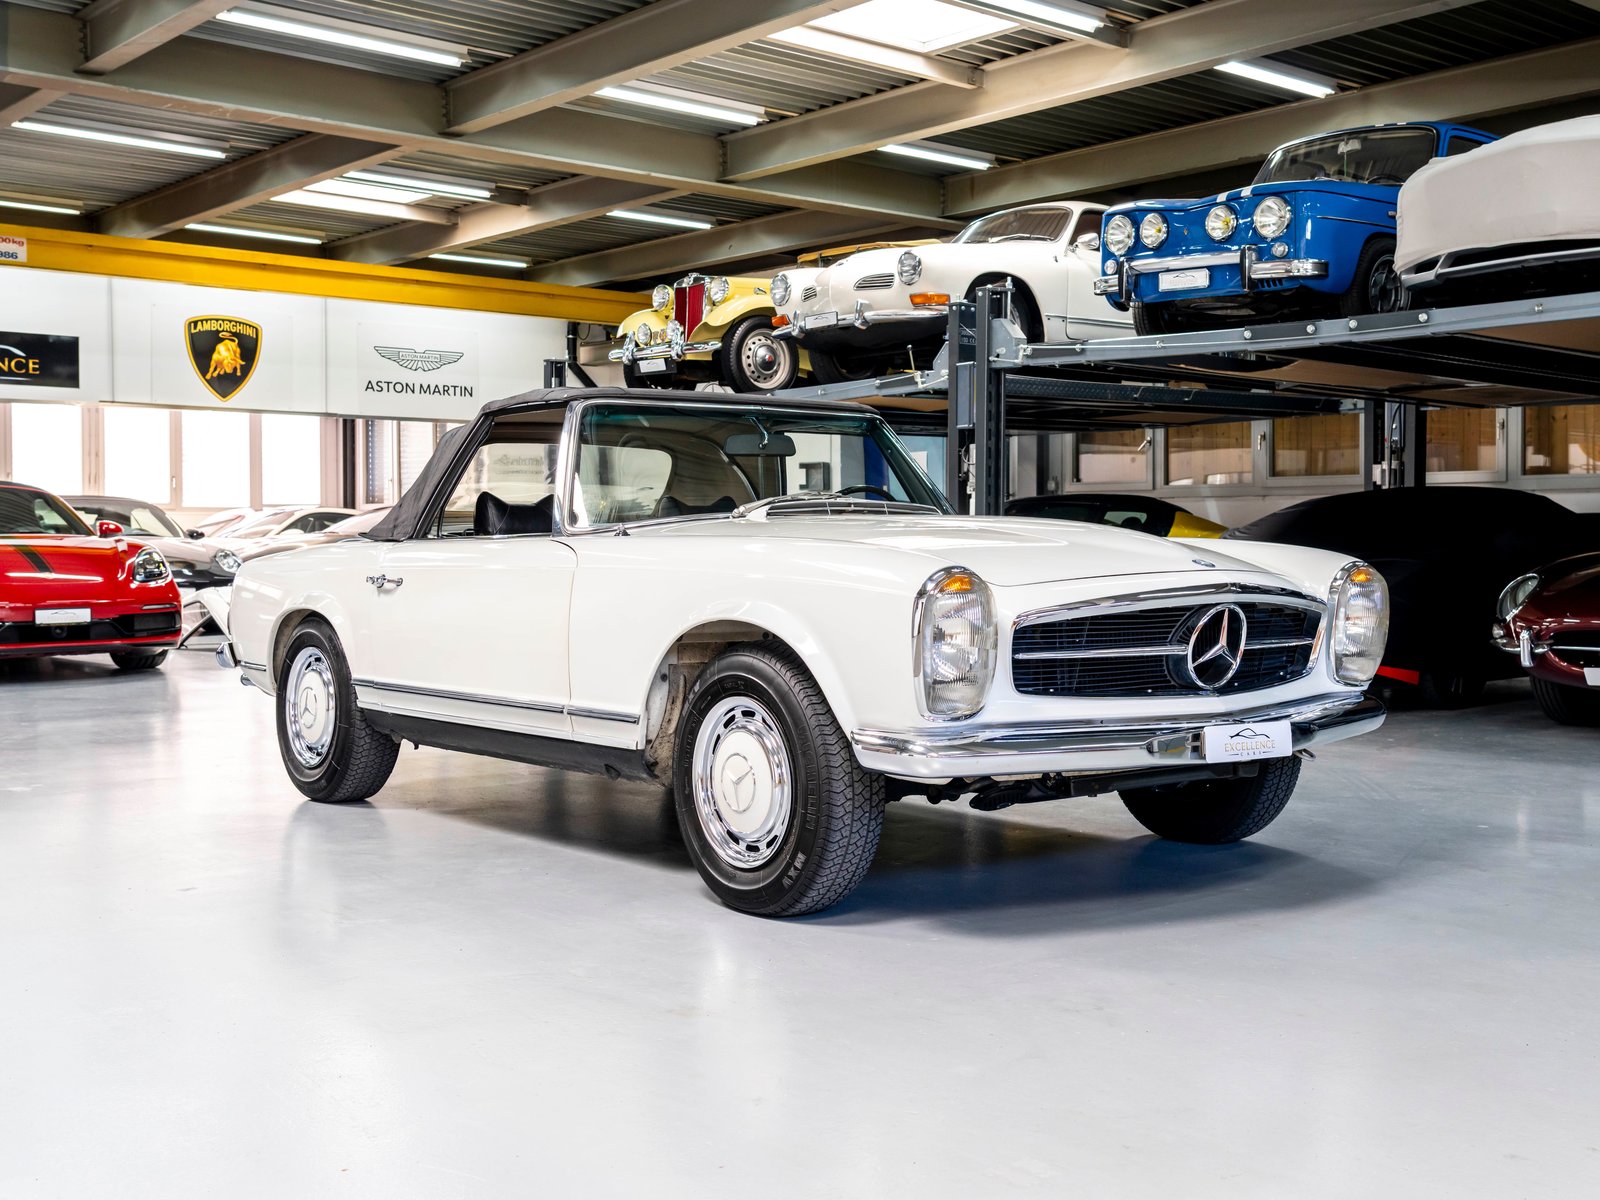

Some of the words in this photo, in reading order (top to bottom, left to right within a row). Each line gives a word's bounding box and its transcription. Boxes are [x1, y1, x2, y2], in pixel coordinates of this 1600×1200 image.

[190, 320, 257, 339] LAMBORGHINI
[364, 380, 415, 394] ASTON
[419, 383, 473, 397] MARTIN
[1224, 740, 1276, 752] EXCELLENCE
